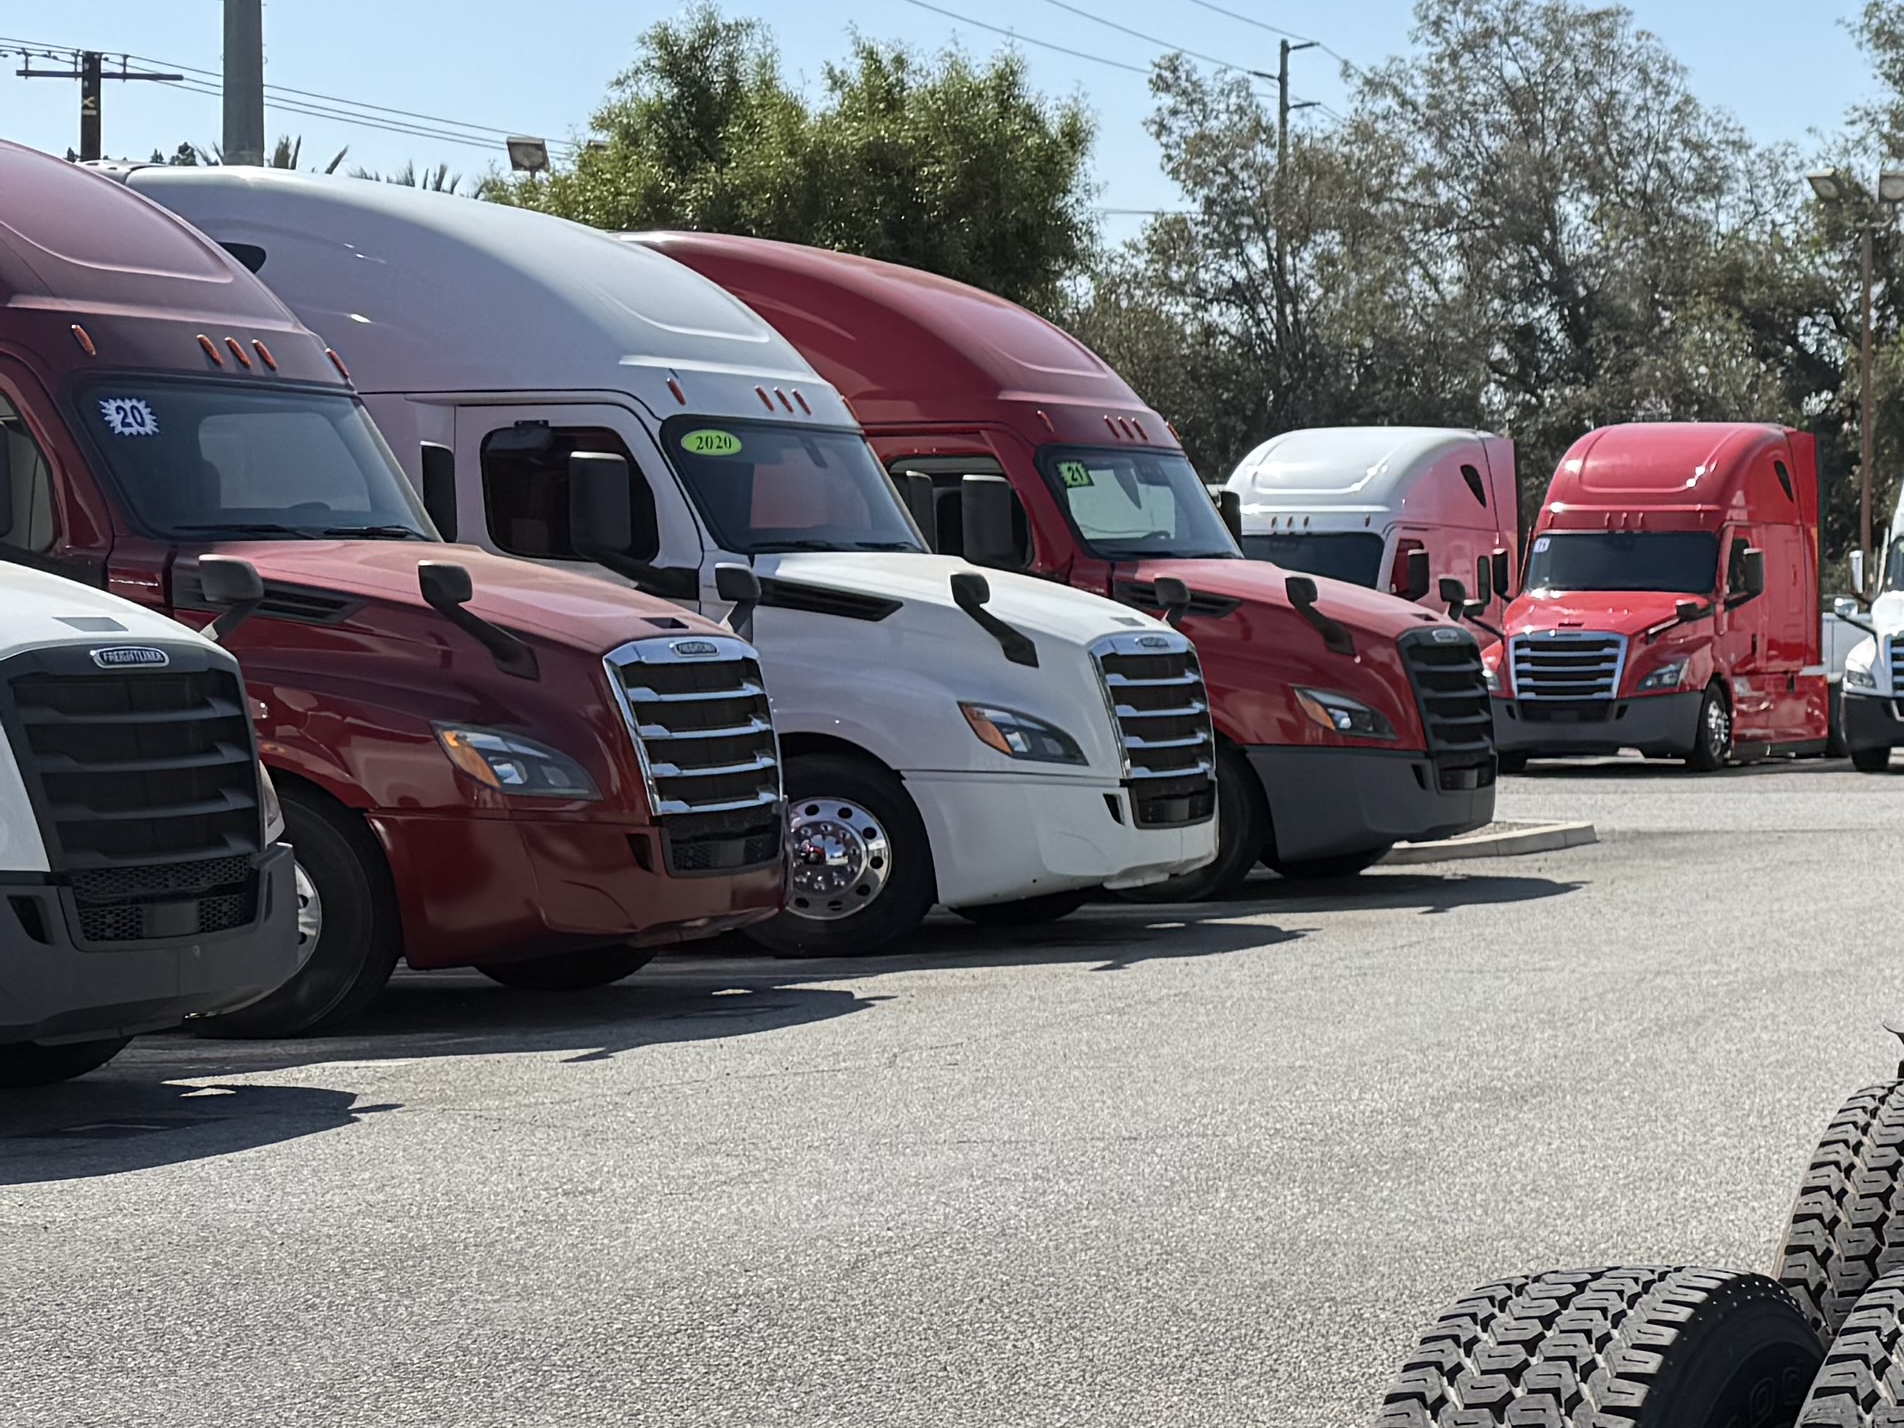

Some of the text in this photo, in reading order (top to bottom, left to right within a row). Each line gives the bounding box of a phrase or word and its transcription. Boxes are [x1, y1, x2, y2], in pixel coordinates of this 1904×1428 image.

[115, 404, 145, 429] 20
[695, 435, 732, 450] 2020
[1067, 465, 1084, 482] 21
